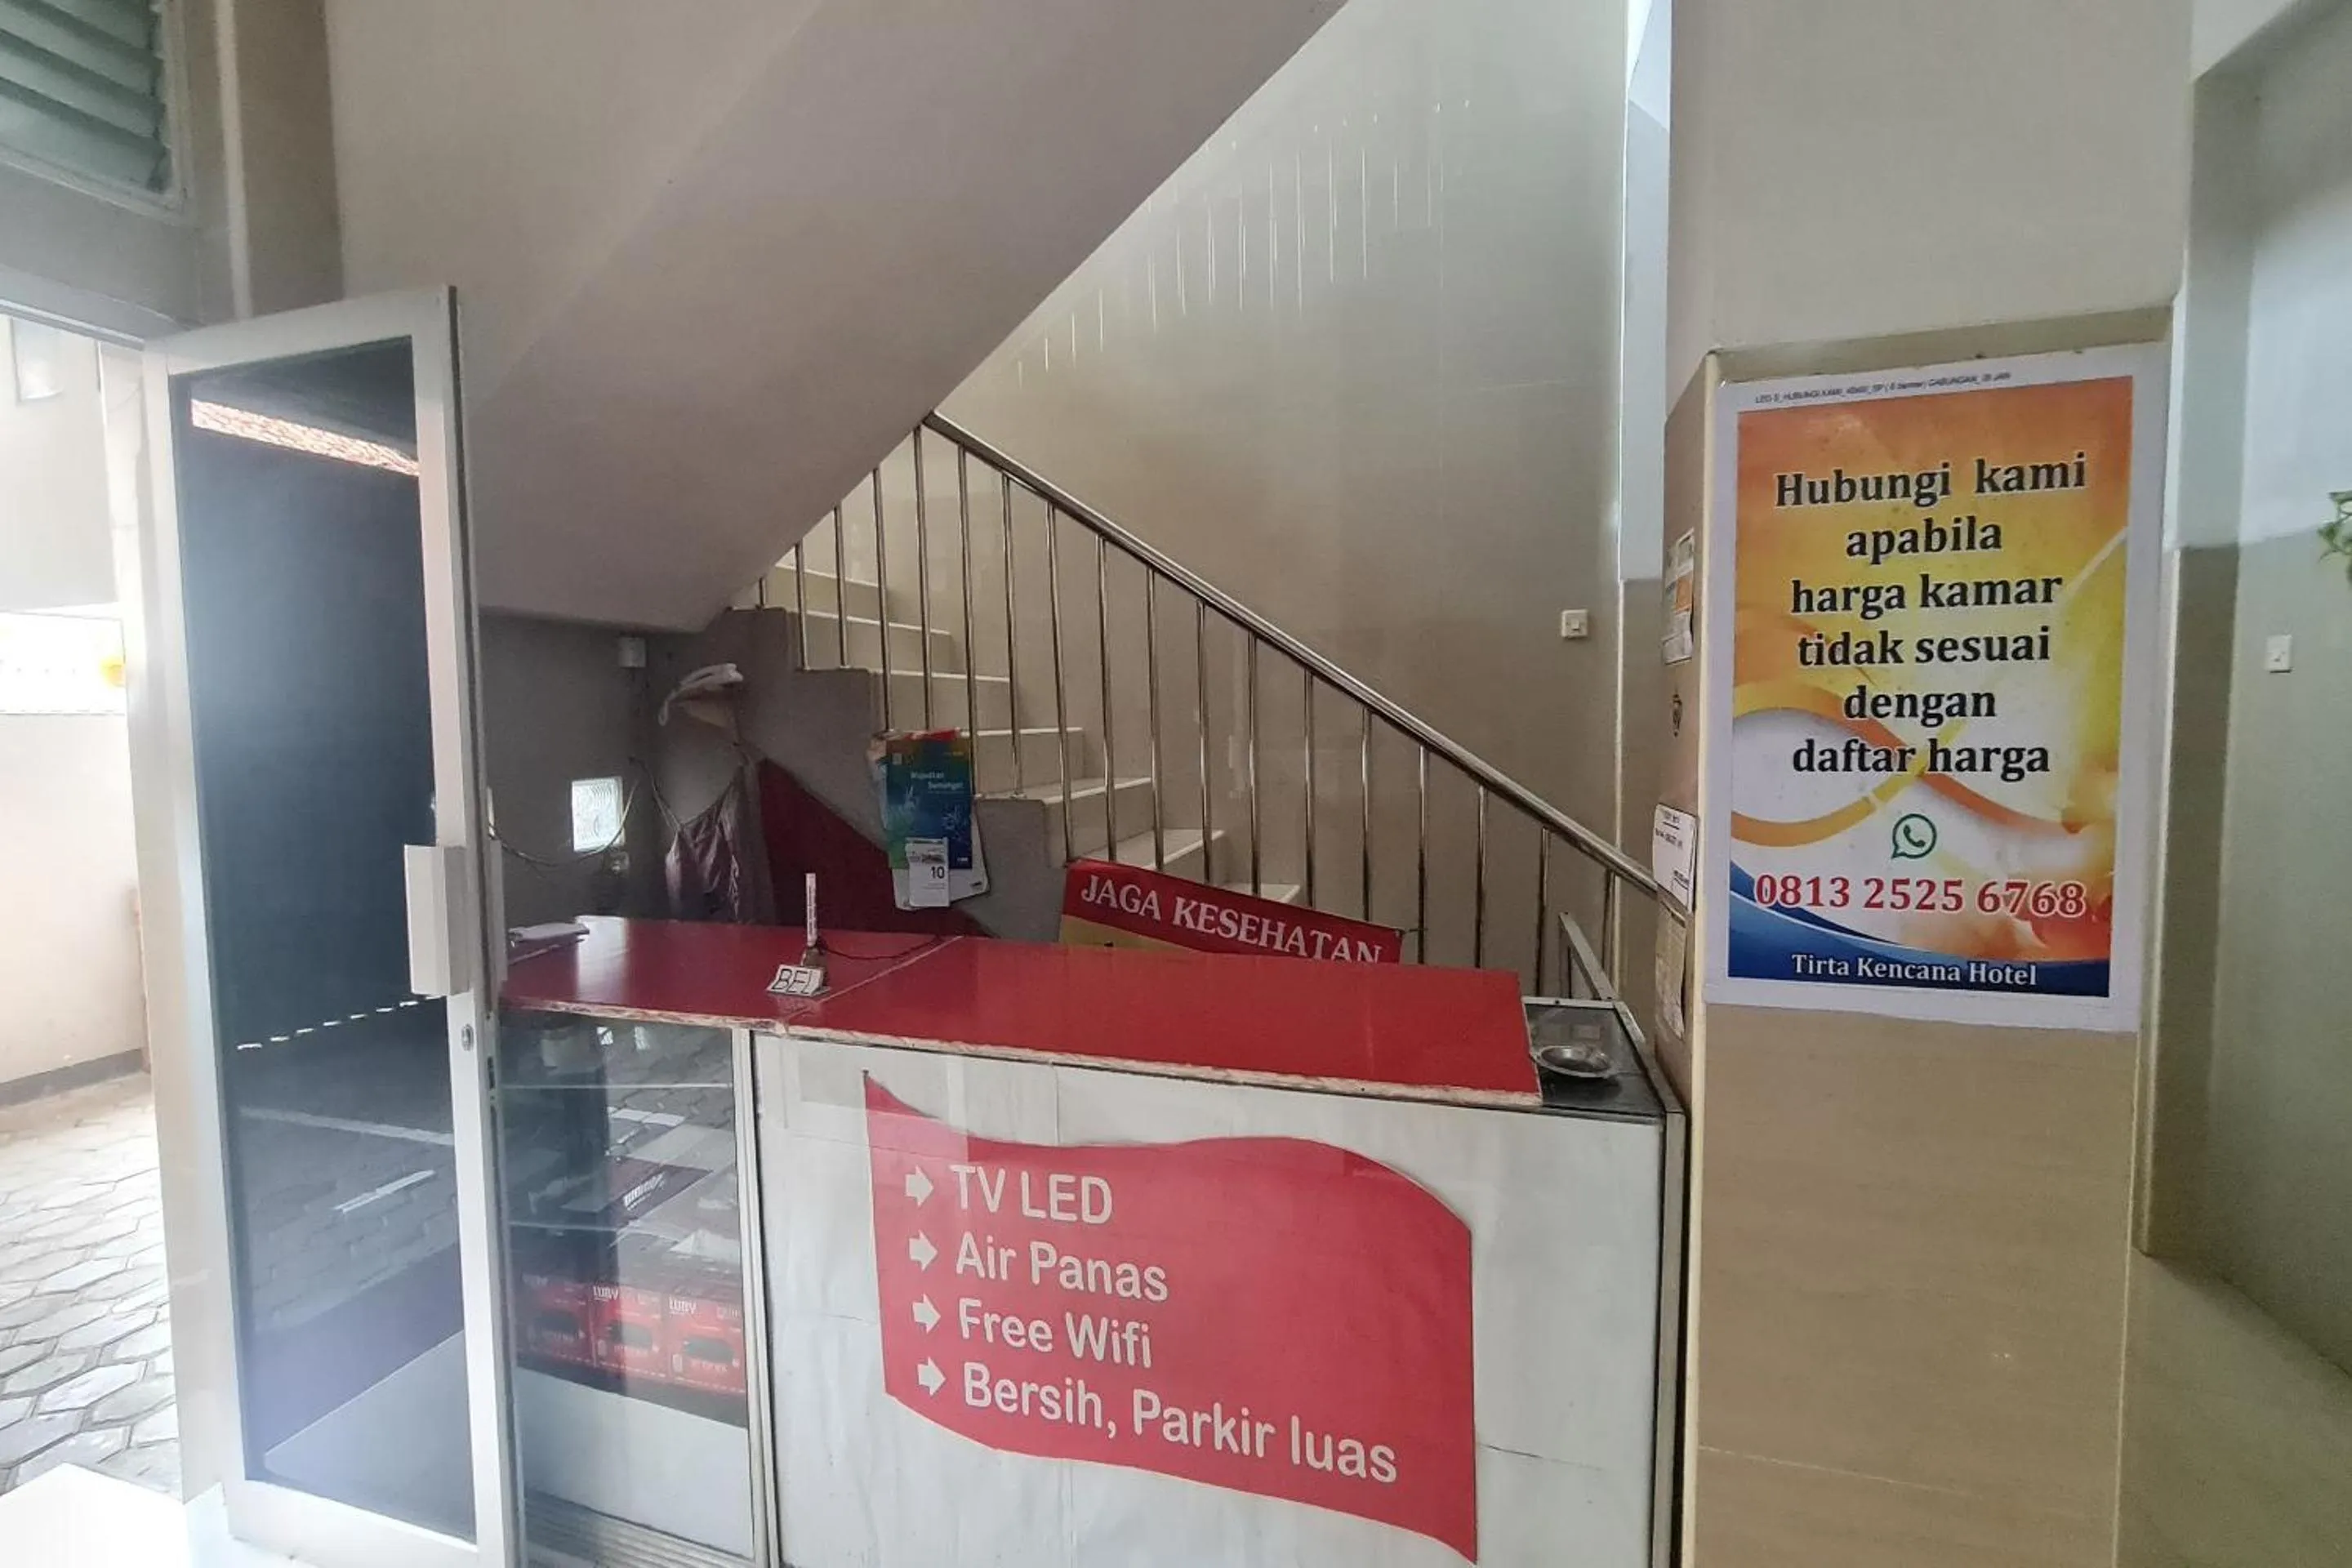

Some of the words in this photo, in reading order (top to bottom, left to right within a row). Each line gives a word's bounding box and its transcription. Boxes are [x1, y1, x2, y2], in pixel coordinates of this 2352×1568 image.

[1775, 463, 1950, 507] Hubungi
[1976, 452, 2086, 492] kami
[1846, 517, 2002, 564] apabila
[1791, 580, 1904, 619] harga
[1919, 574, 2062, 608] kamar
[1797, 632, 1903, 666] tidak
[1915, 626, 2050, 663] sesuai
[1844, 686, 1996, 726] dengan
[1793, 738, 1915, 773] daftar
[1928, 739, 2050, 782] harga
[931, 866, 945, 879] 10
[1755, 875, 1851, 909] 0813
[1863, 877, 1963, 912] 2525
[1978, 881, 2086, 916] 6768
[1081, 874, 1160, 921] JAGA
[1172, 896, 1382, 963] KESEHATAN
[771, 968, 813, 995] BEL
[1791, 954, 1850, 976] Tirta
[1857, 957, 1960, 982] Kencana
[1969, 962, 2038, 986] Hotel
[949, 1165, 1006, 1213] TV
[1021, 1171, 1113, 1224] LED
[956, 1232, 1016, 1281] Air
[1029, 1241, 1168, 1303] Panas
[959, 1298, 1054, 1352] Free
[1065, 1312, 1152, 1369] Wifi
[963, 1361, 1116, 1440] Bersih,
[1132, 1389, 1276, 1459] Parkir
[1290, 1414, 1398, 1483] luas
